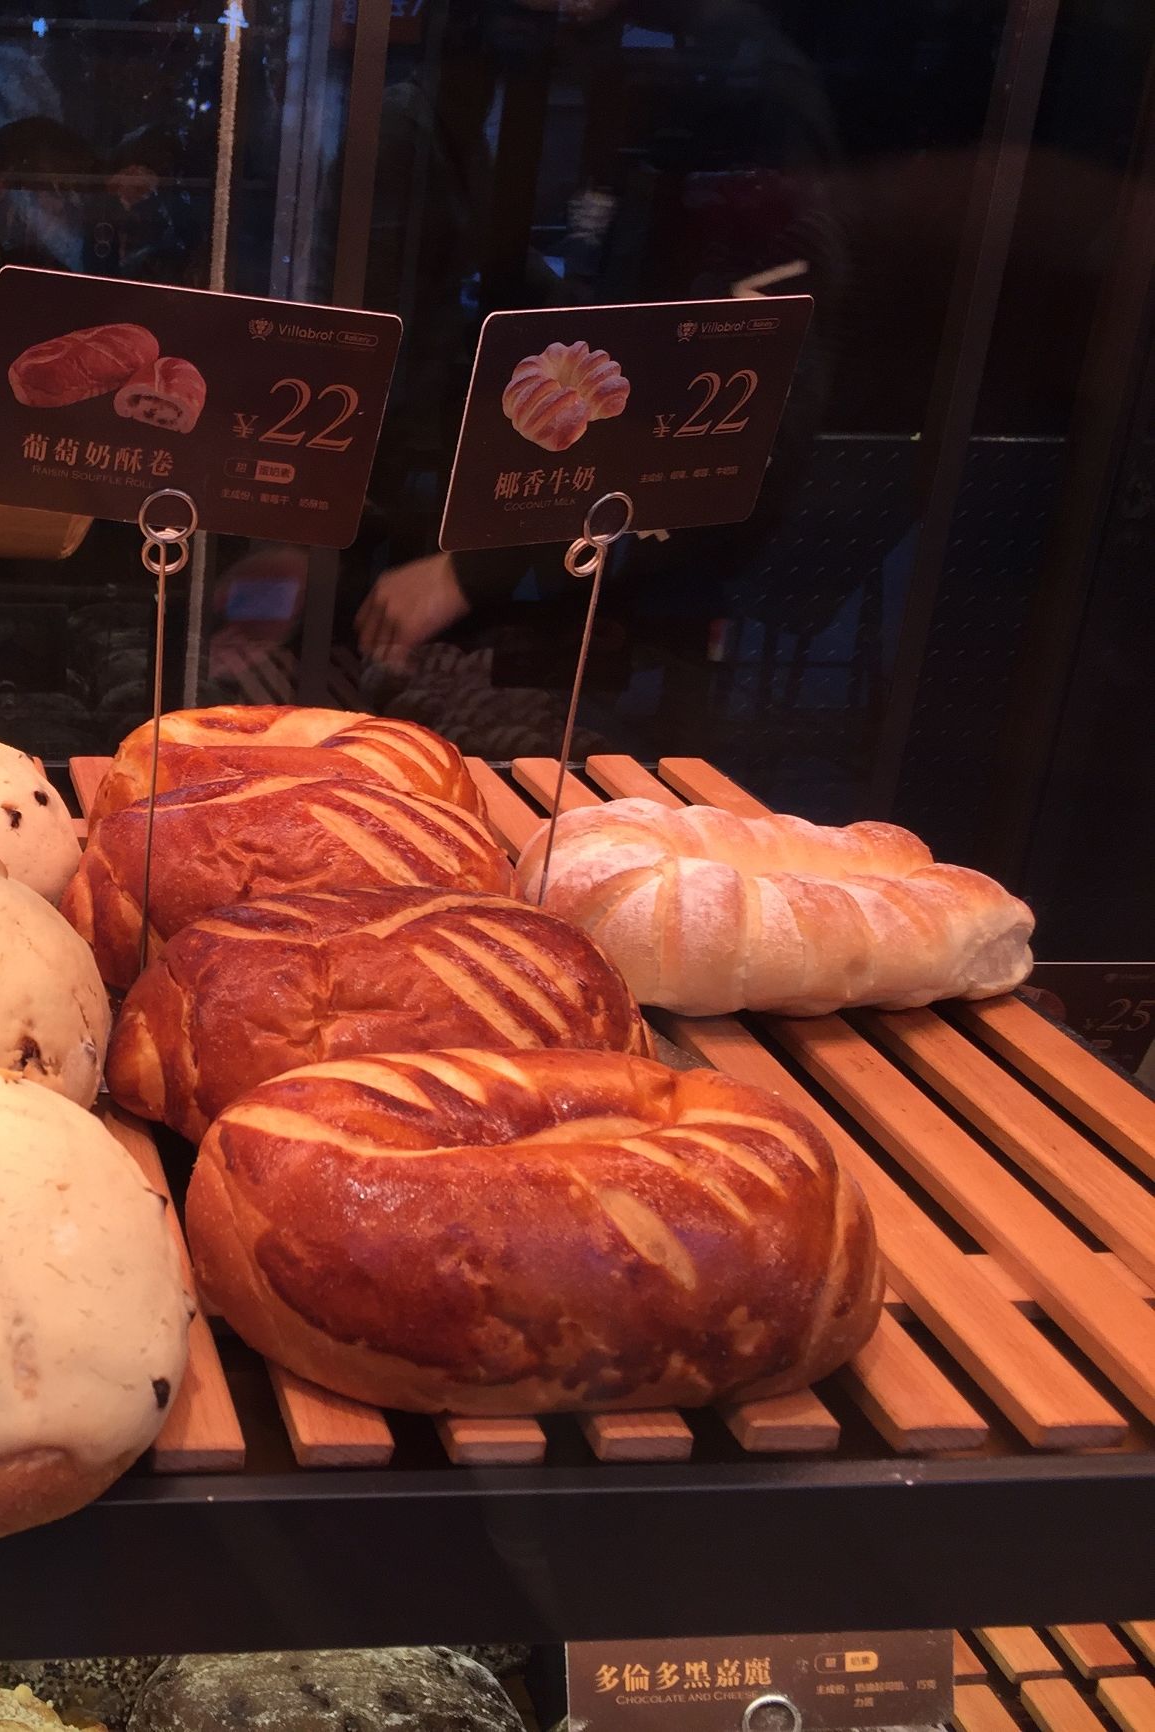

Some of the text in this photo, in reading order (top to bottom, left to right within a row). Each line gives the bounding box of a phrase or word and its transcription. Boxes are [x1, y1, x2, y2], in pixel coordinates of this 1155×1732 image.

[278, 323, 335, 342] Villabrot
[22, 433, 175, 477] 葡萄奶酥卷
[493, 466, 597, 500] 椰香牛奶
[615, 1693, 686, 1705] CHOCOLATE
